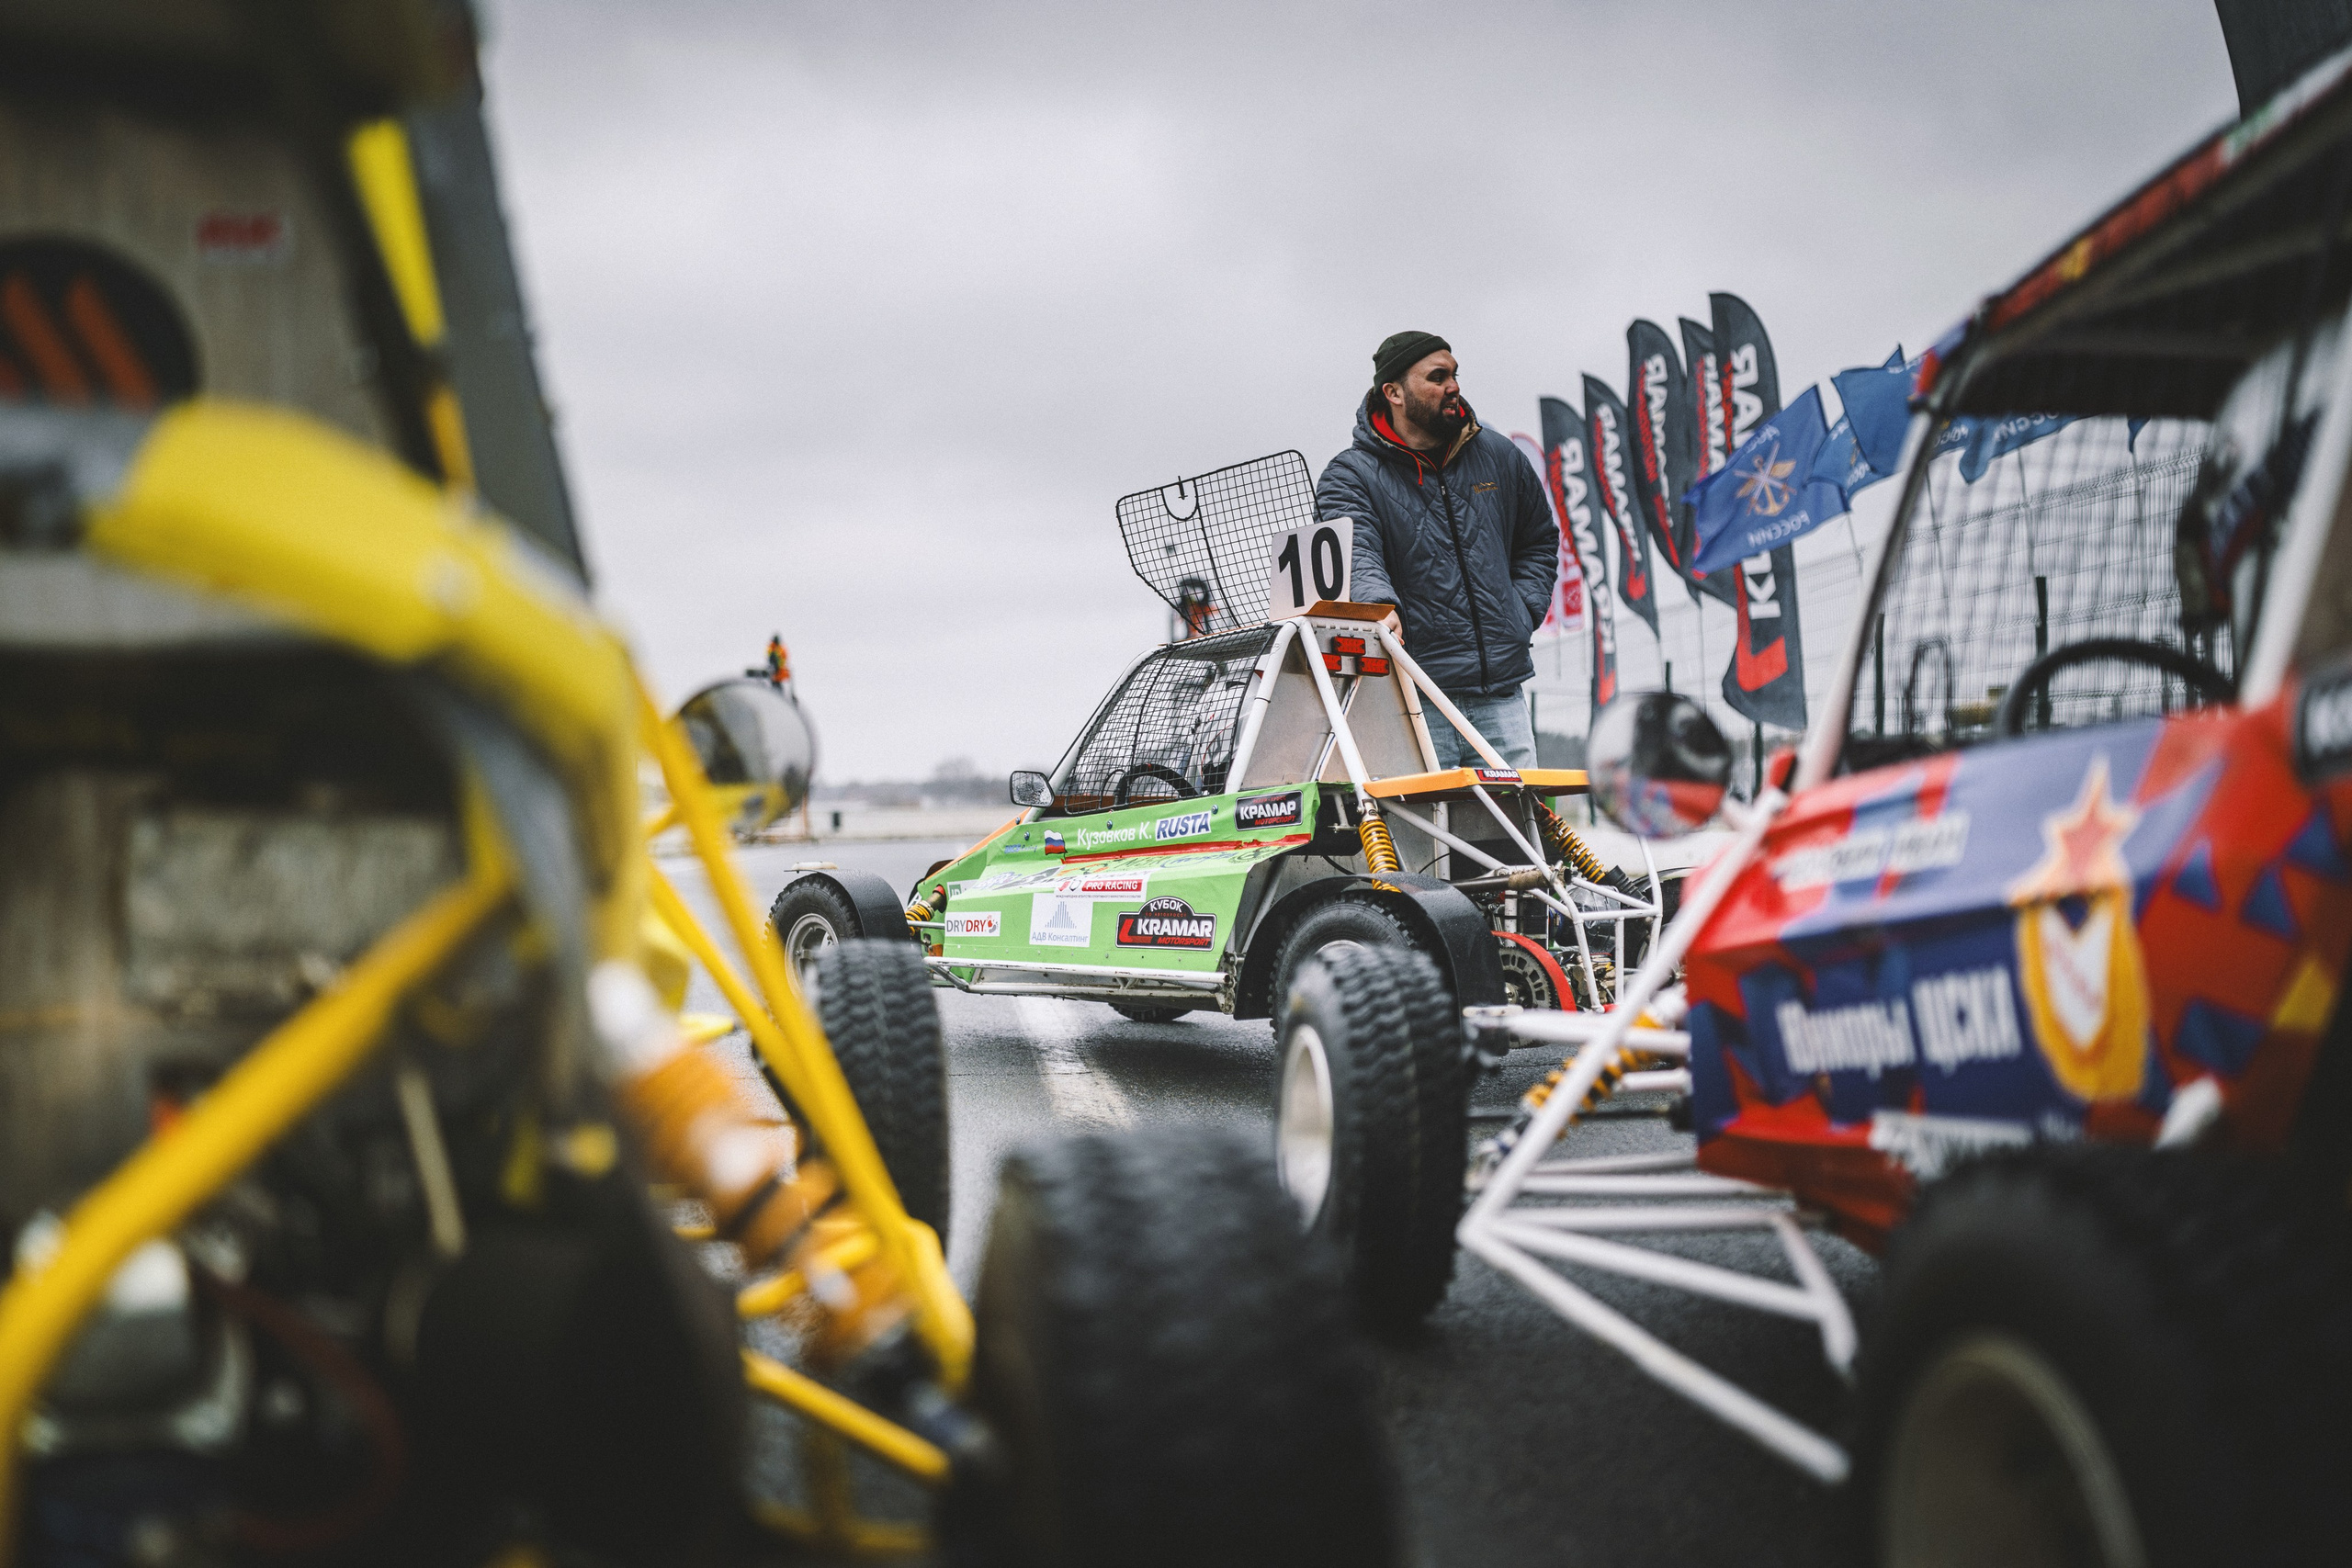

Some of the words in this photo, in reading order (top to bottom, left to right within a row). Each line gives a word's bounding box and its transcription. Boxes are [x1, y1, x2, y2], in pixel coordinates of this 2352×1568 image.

[1278, 526, 1344, 608] 10
[1483, 770, 1521, 779] KRAMAR
[1240, 800, 1296, 820] КРАМАР
[1157, 812, 1210, 840] RUSTA
[1254, 815, 1296, 826] МОТОРСПОРТ
[1077, 828, 1136, 851] Кузовков
[1138, 821, 1152, 840] К.
[1086, 881, 1103, 890] PRO
[1104, 880, 1138, 890] RACING
[1149, 899, 1183, 913] КУБОК
[946, 919, 986, 933] DRYDRY
[1136, 919, 1213, 937] KRAMAR
[1031, 931, 1046, 942] АДВ
[1047, 932, 1089, 943] Консалтинг
[1157, 937, 1212, 946] MOTORSPORT
